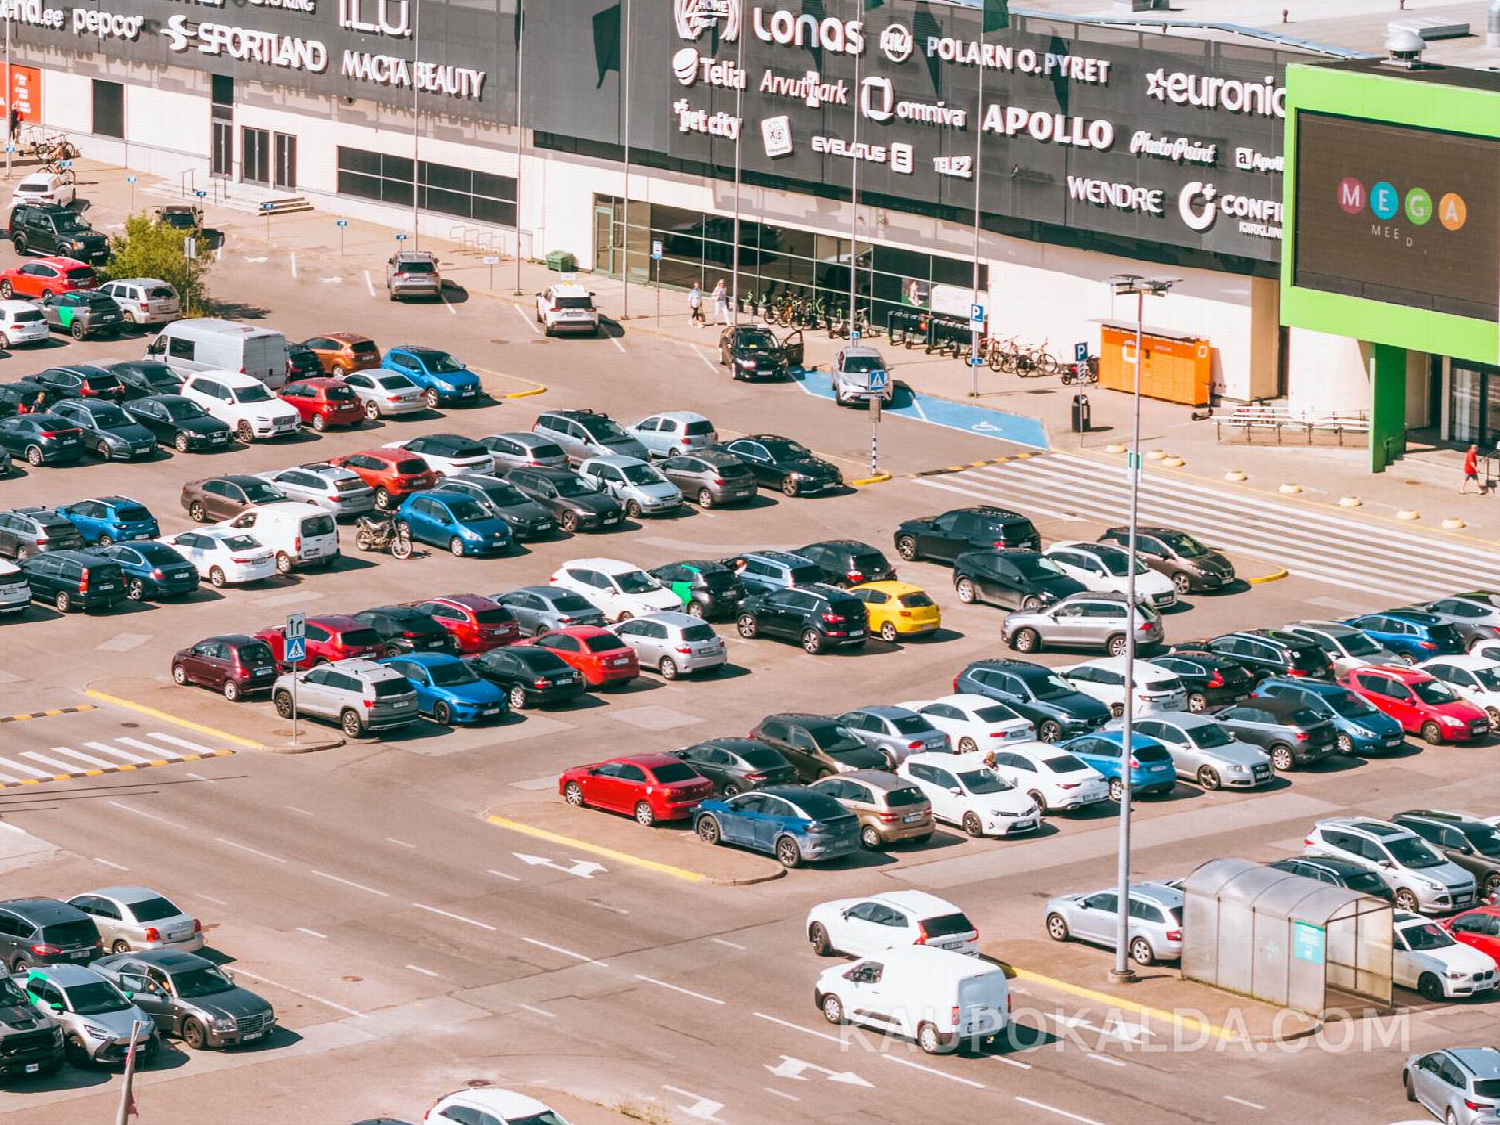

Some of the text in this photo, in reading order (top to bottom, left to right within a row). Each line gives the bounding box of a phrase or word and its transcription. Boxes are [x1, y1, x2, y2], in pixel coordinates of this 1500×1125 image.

[72, 8, 144, 39] pepco
[198, 22, 328, 73] SPORTLAND
[926, 36, 1013, 70] POLARN
[1043, 52, 1111, 84] PYRET
[341, 49, 487, 98] MACTA BEAUTY
[700, 57, 747, 90] Telia
[896, 101, 967, 127] omniva
[982, 104, 1114, 150] APOLLO
[932, 155, 973, 179] TELE2
[1067, 176, 1164, 214] WENDRE
[1221, 194, 1284, 223] CONFI
[1341, 182, 1459, 223] MEGA
